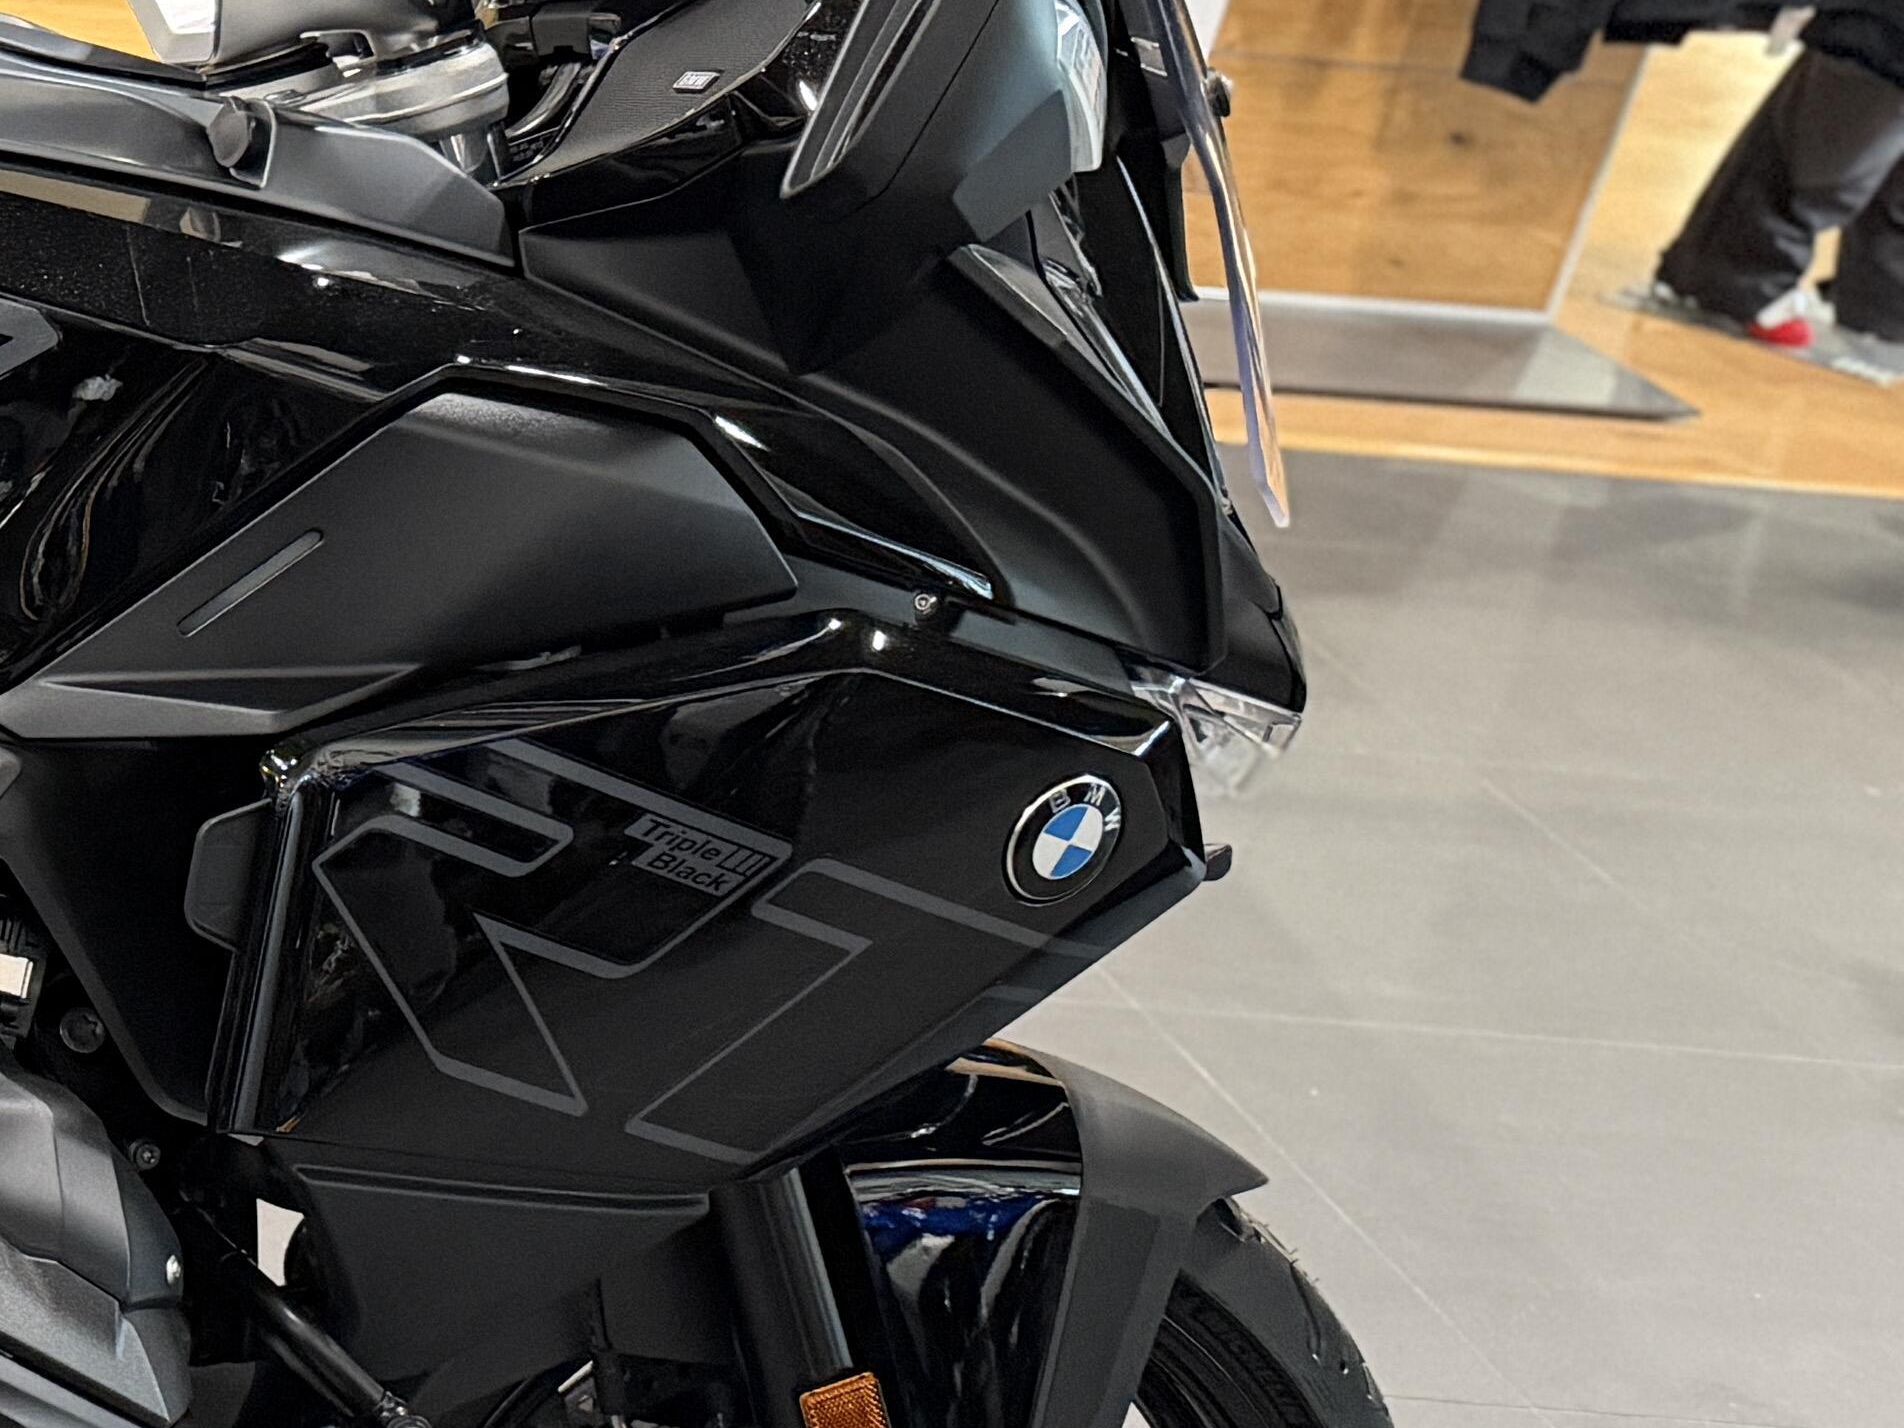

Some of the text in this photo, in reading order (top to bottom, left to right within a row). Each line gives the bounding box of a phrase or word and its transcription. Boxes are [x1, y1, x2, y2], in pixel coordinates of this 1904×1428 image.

[1049, 783, 1121, 831] BMW
[642, 819, 721, 860] Triple
[648, 852, 729, 891] Black
